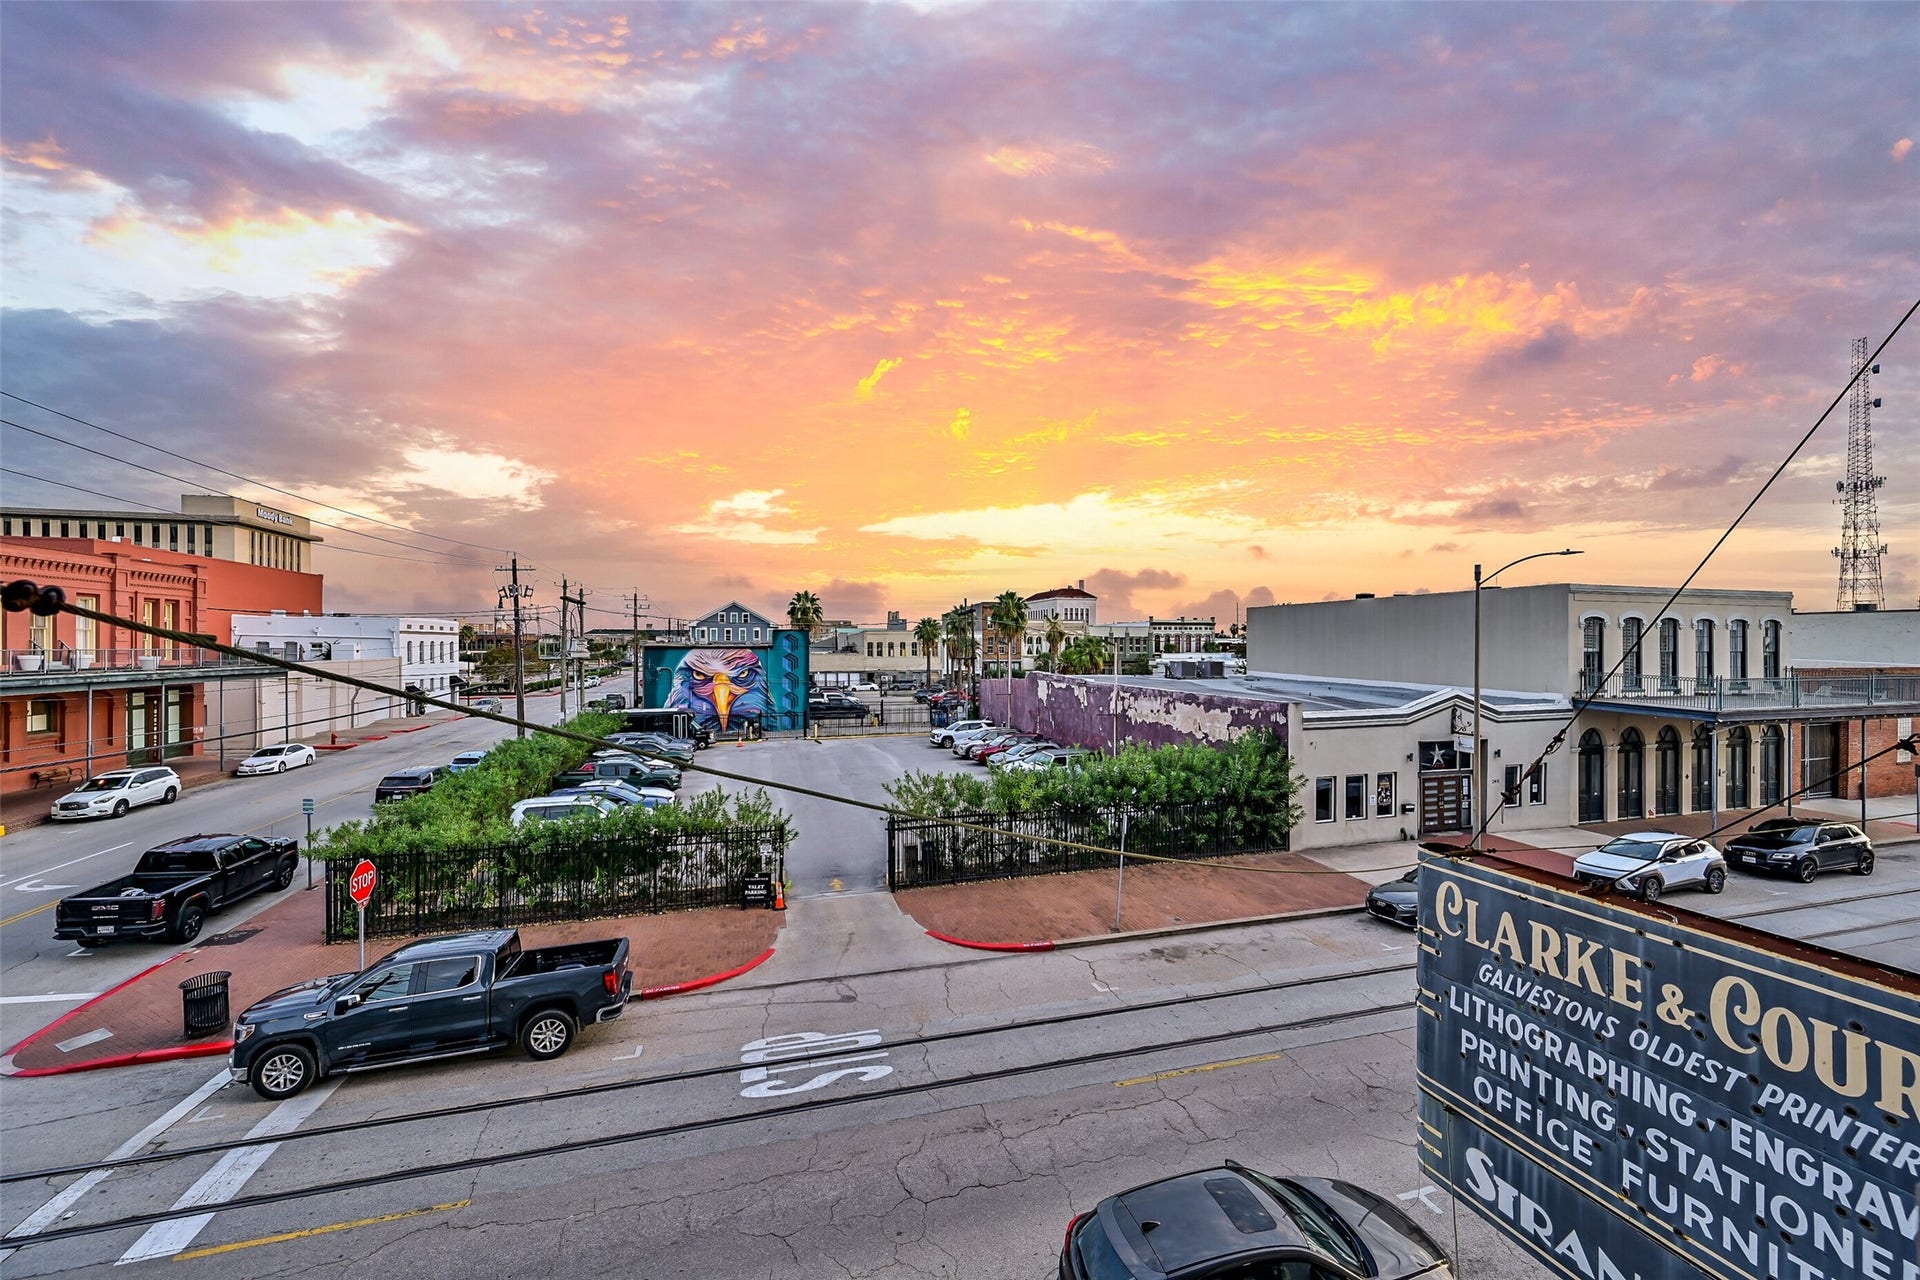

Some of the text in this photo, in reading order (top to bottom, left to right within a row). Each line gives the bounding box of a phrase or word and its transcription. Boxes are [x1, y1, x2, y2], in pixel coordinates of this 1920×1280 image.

[257, 507, 293, 526] Moody Bank
[352, 870, 374, 893] STOP
[1436, 881, 1642, 1011] CLARKE
[1657, 984, 1696, 1031] &
[1479, 964, 1920, 1177] GALVESTONS OLDEST PRINTER
[1474, 1077, 1606, 1166] OFFICE
